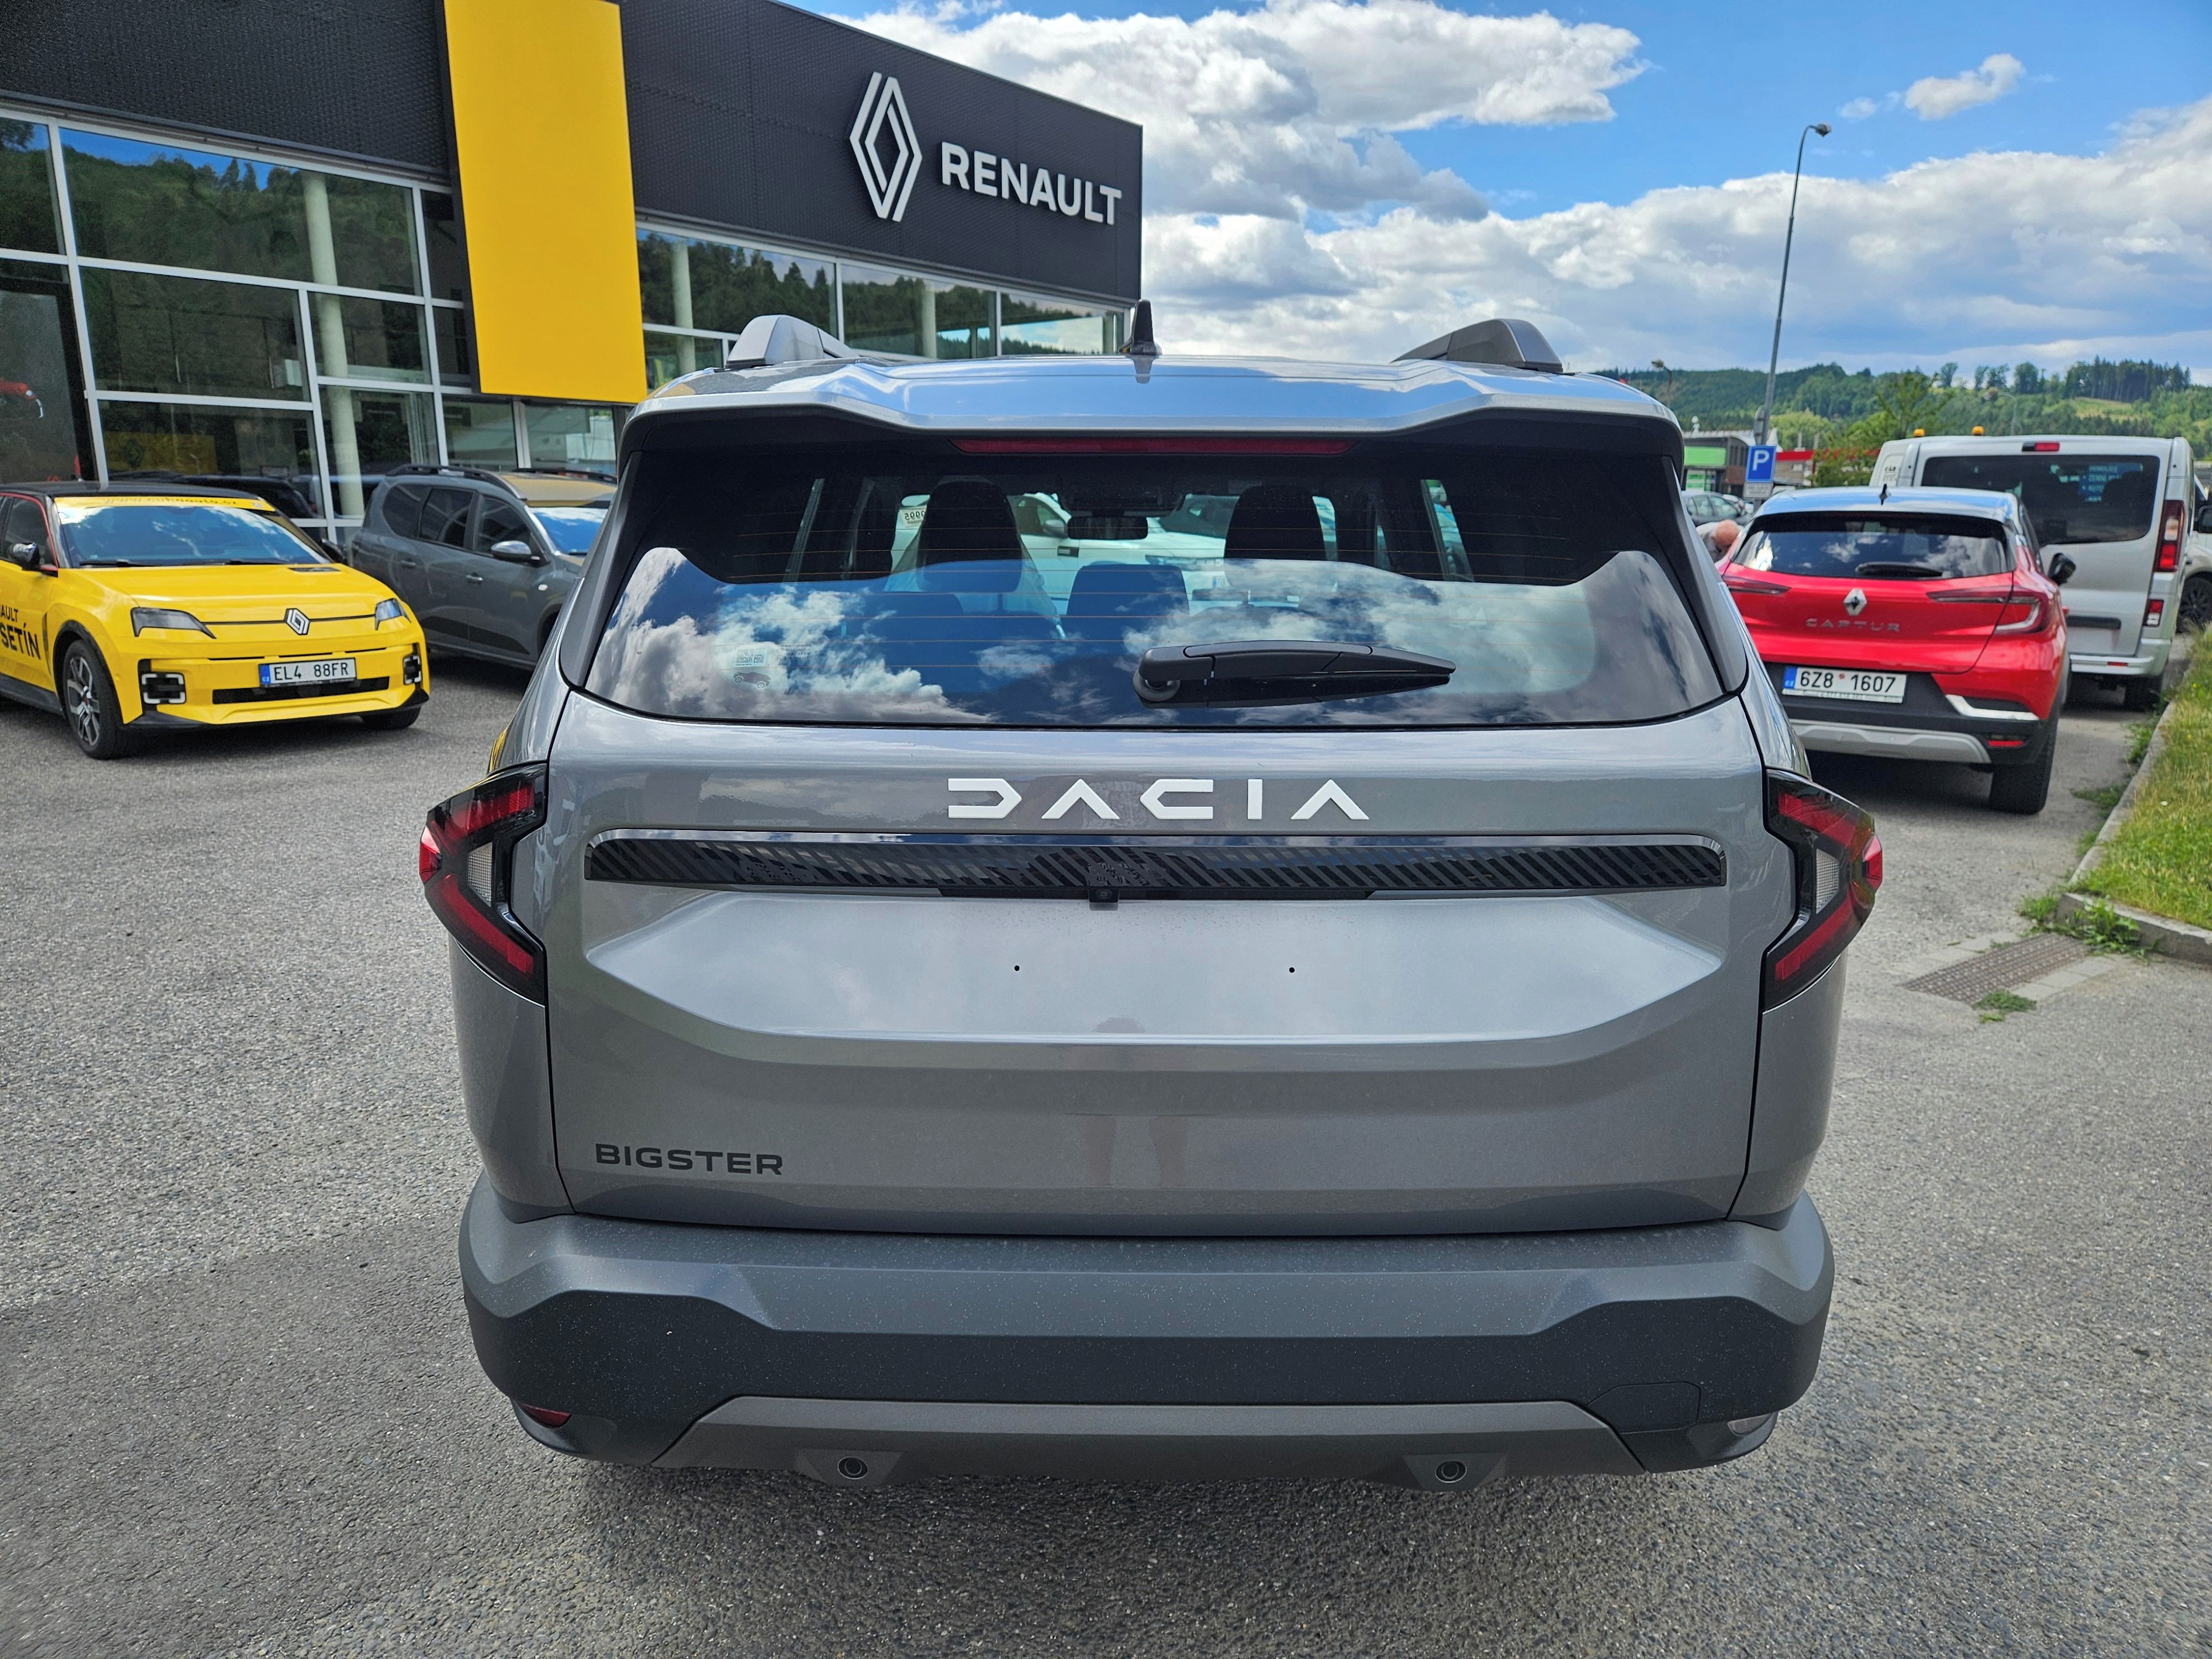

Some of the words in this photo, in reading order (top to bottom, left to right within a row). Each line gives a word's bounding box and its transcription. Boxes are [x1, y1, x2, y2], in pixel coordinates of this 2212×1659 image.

[942, 142, 1122, 225] RENAULT
[1752, 450, 1770, 471] P
[1806, 618, 1900, 633] CAPTUR
[274, 665, 301, 681] EL4
[314, 662, 348, 677] 88FR
[1800, 671, 1834, 688] 6Z8
[1850, 675, 1896, 692] 1607
[948, 778, 1369, 820] DACIA
[595, 1144, 782, 1175] BIGSTER
